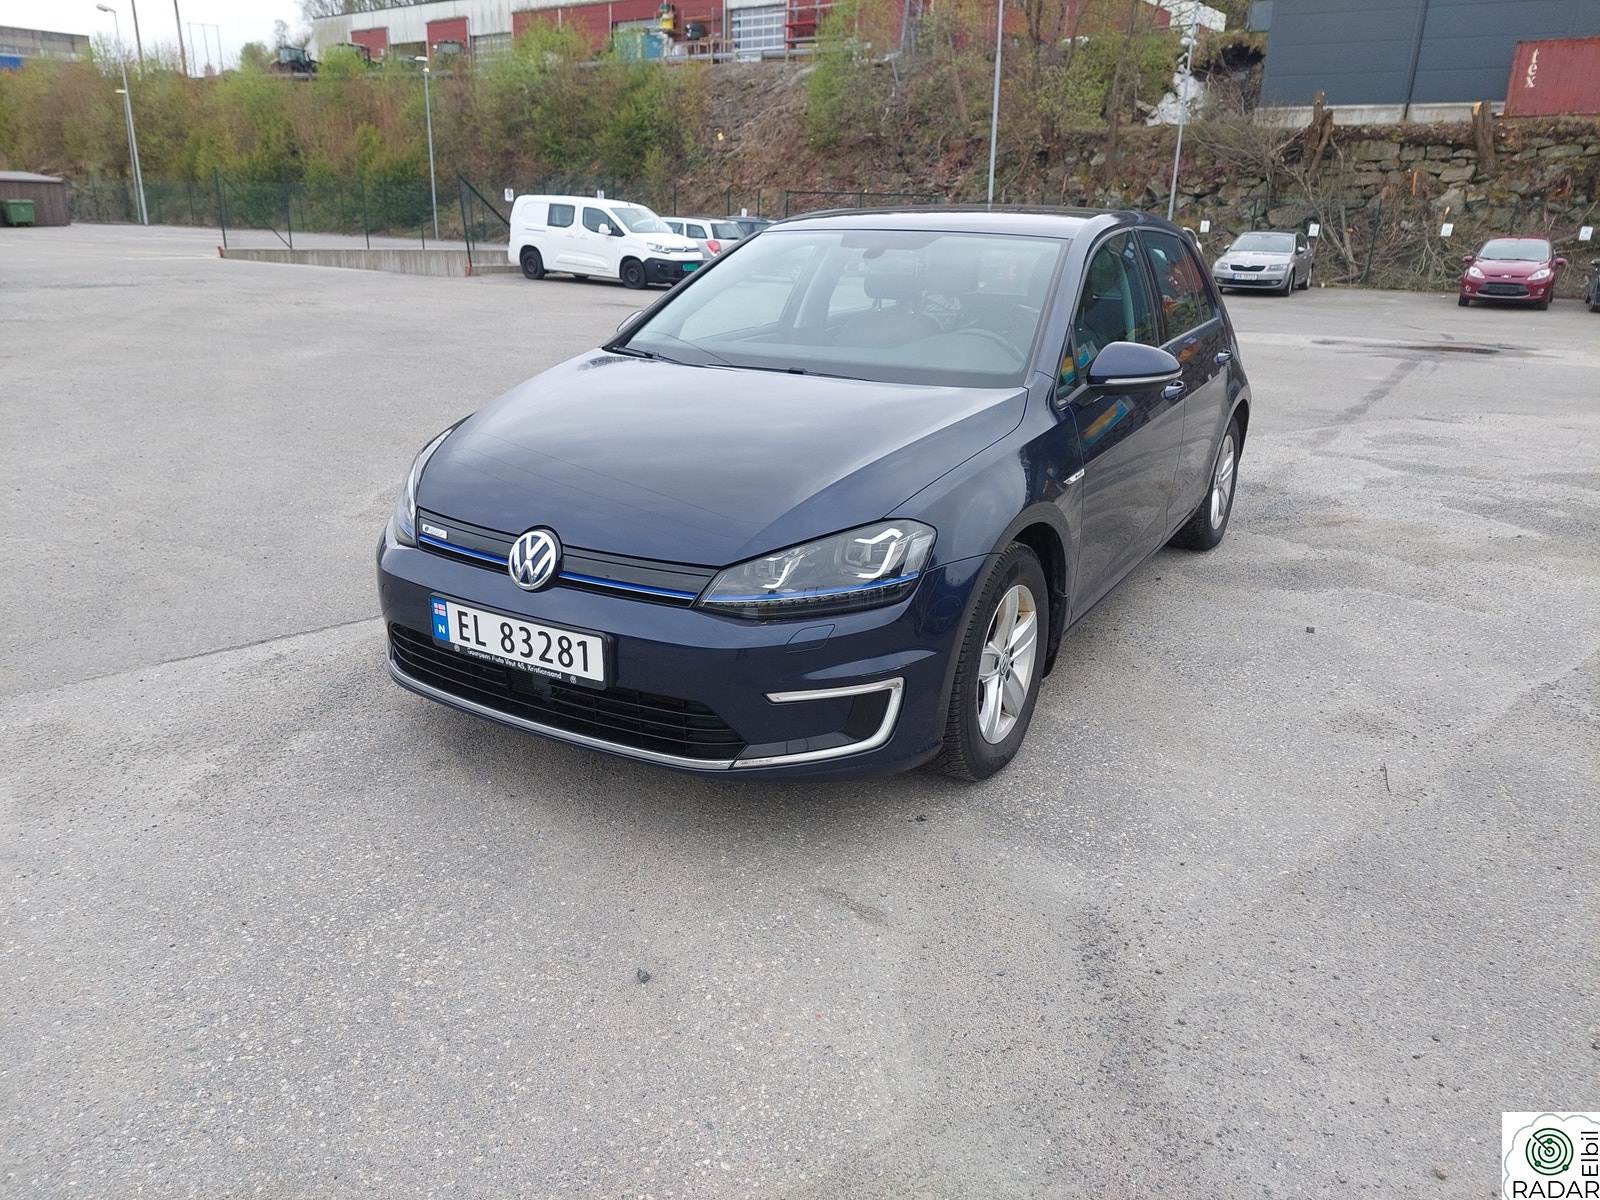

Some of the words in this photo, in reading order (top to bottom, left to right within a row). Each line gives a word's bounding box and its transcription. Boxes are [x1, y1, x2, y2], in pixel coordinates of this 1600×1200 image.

[438, 623, 446, 634] N
[457, 610, 487, 647] EL
[500, 622, 589, 672] 83281
